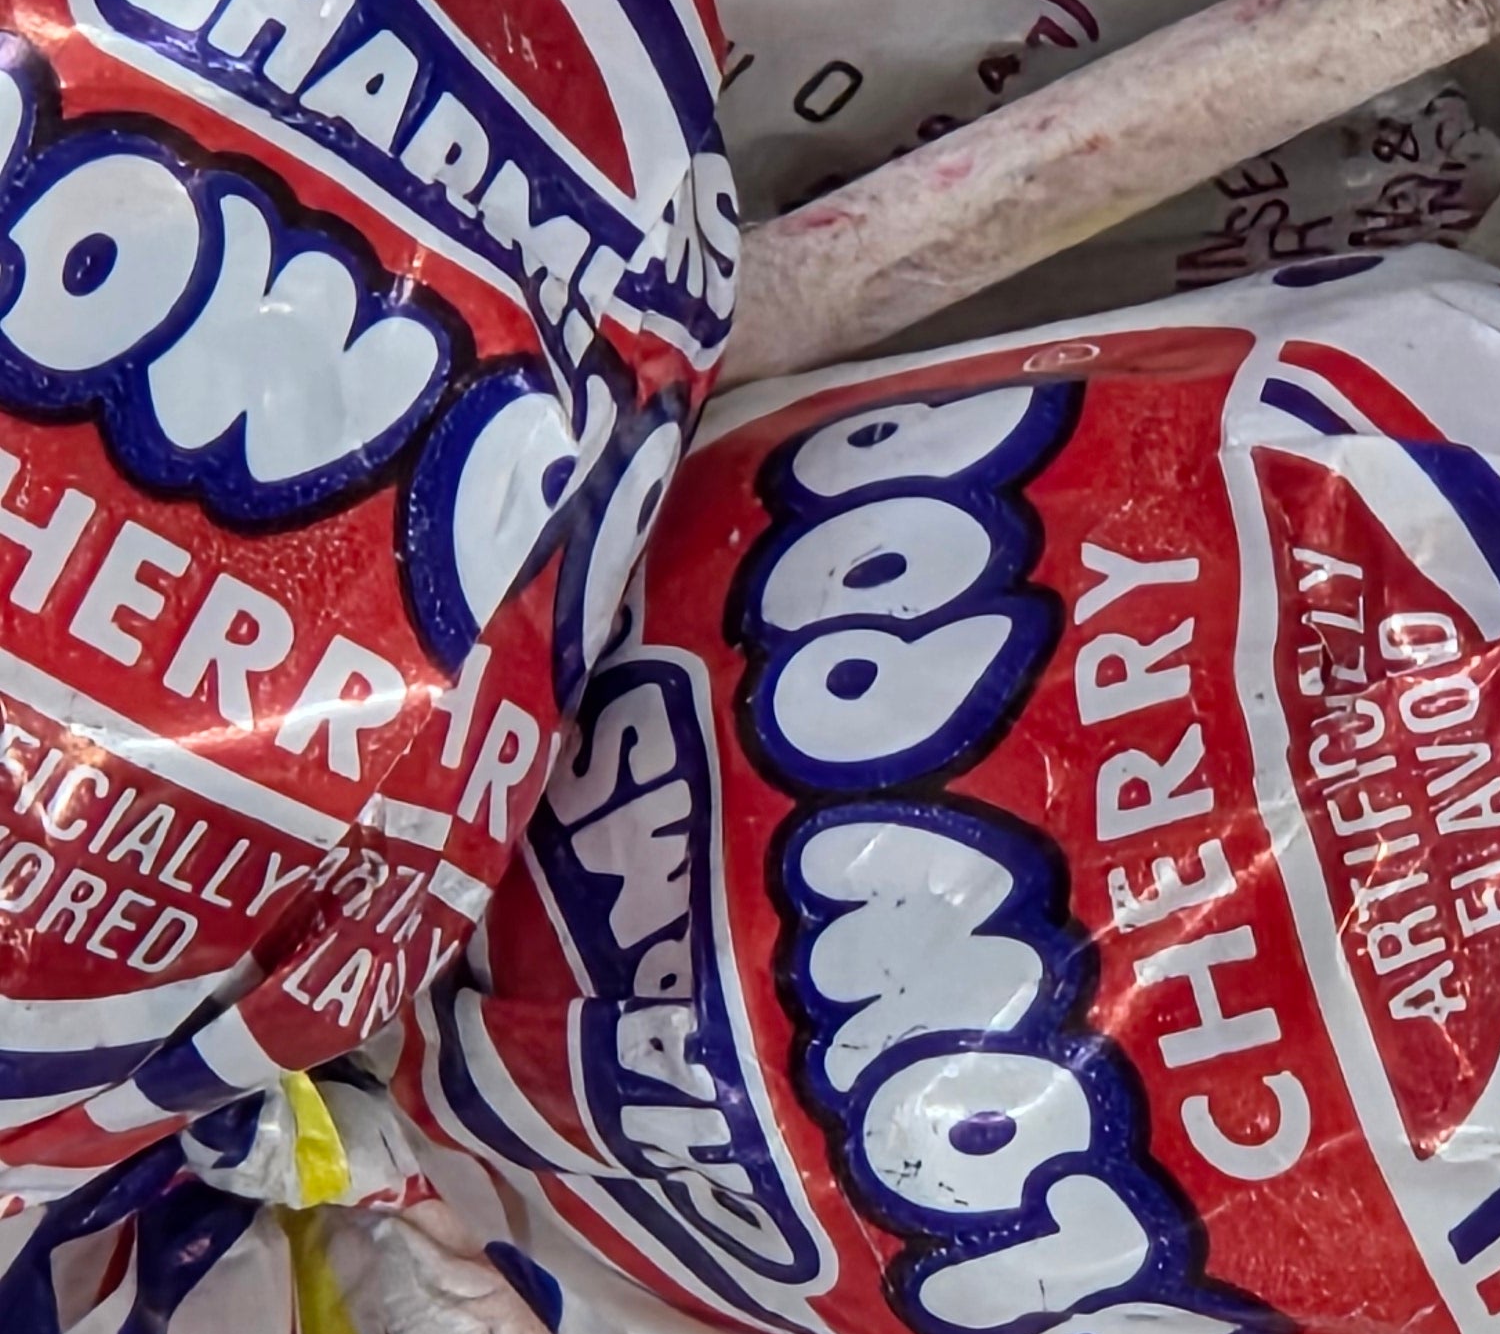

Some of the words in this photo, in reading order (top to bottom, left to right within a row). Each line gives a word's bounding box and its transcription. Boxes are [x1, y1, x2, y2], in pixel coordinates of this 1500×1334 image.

[742, 380, 1058, 779] POP
[0, 827, 199, 973] ORED
[1072, 542, 1312, 1181] CHERRY
